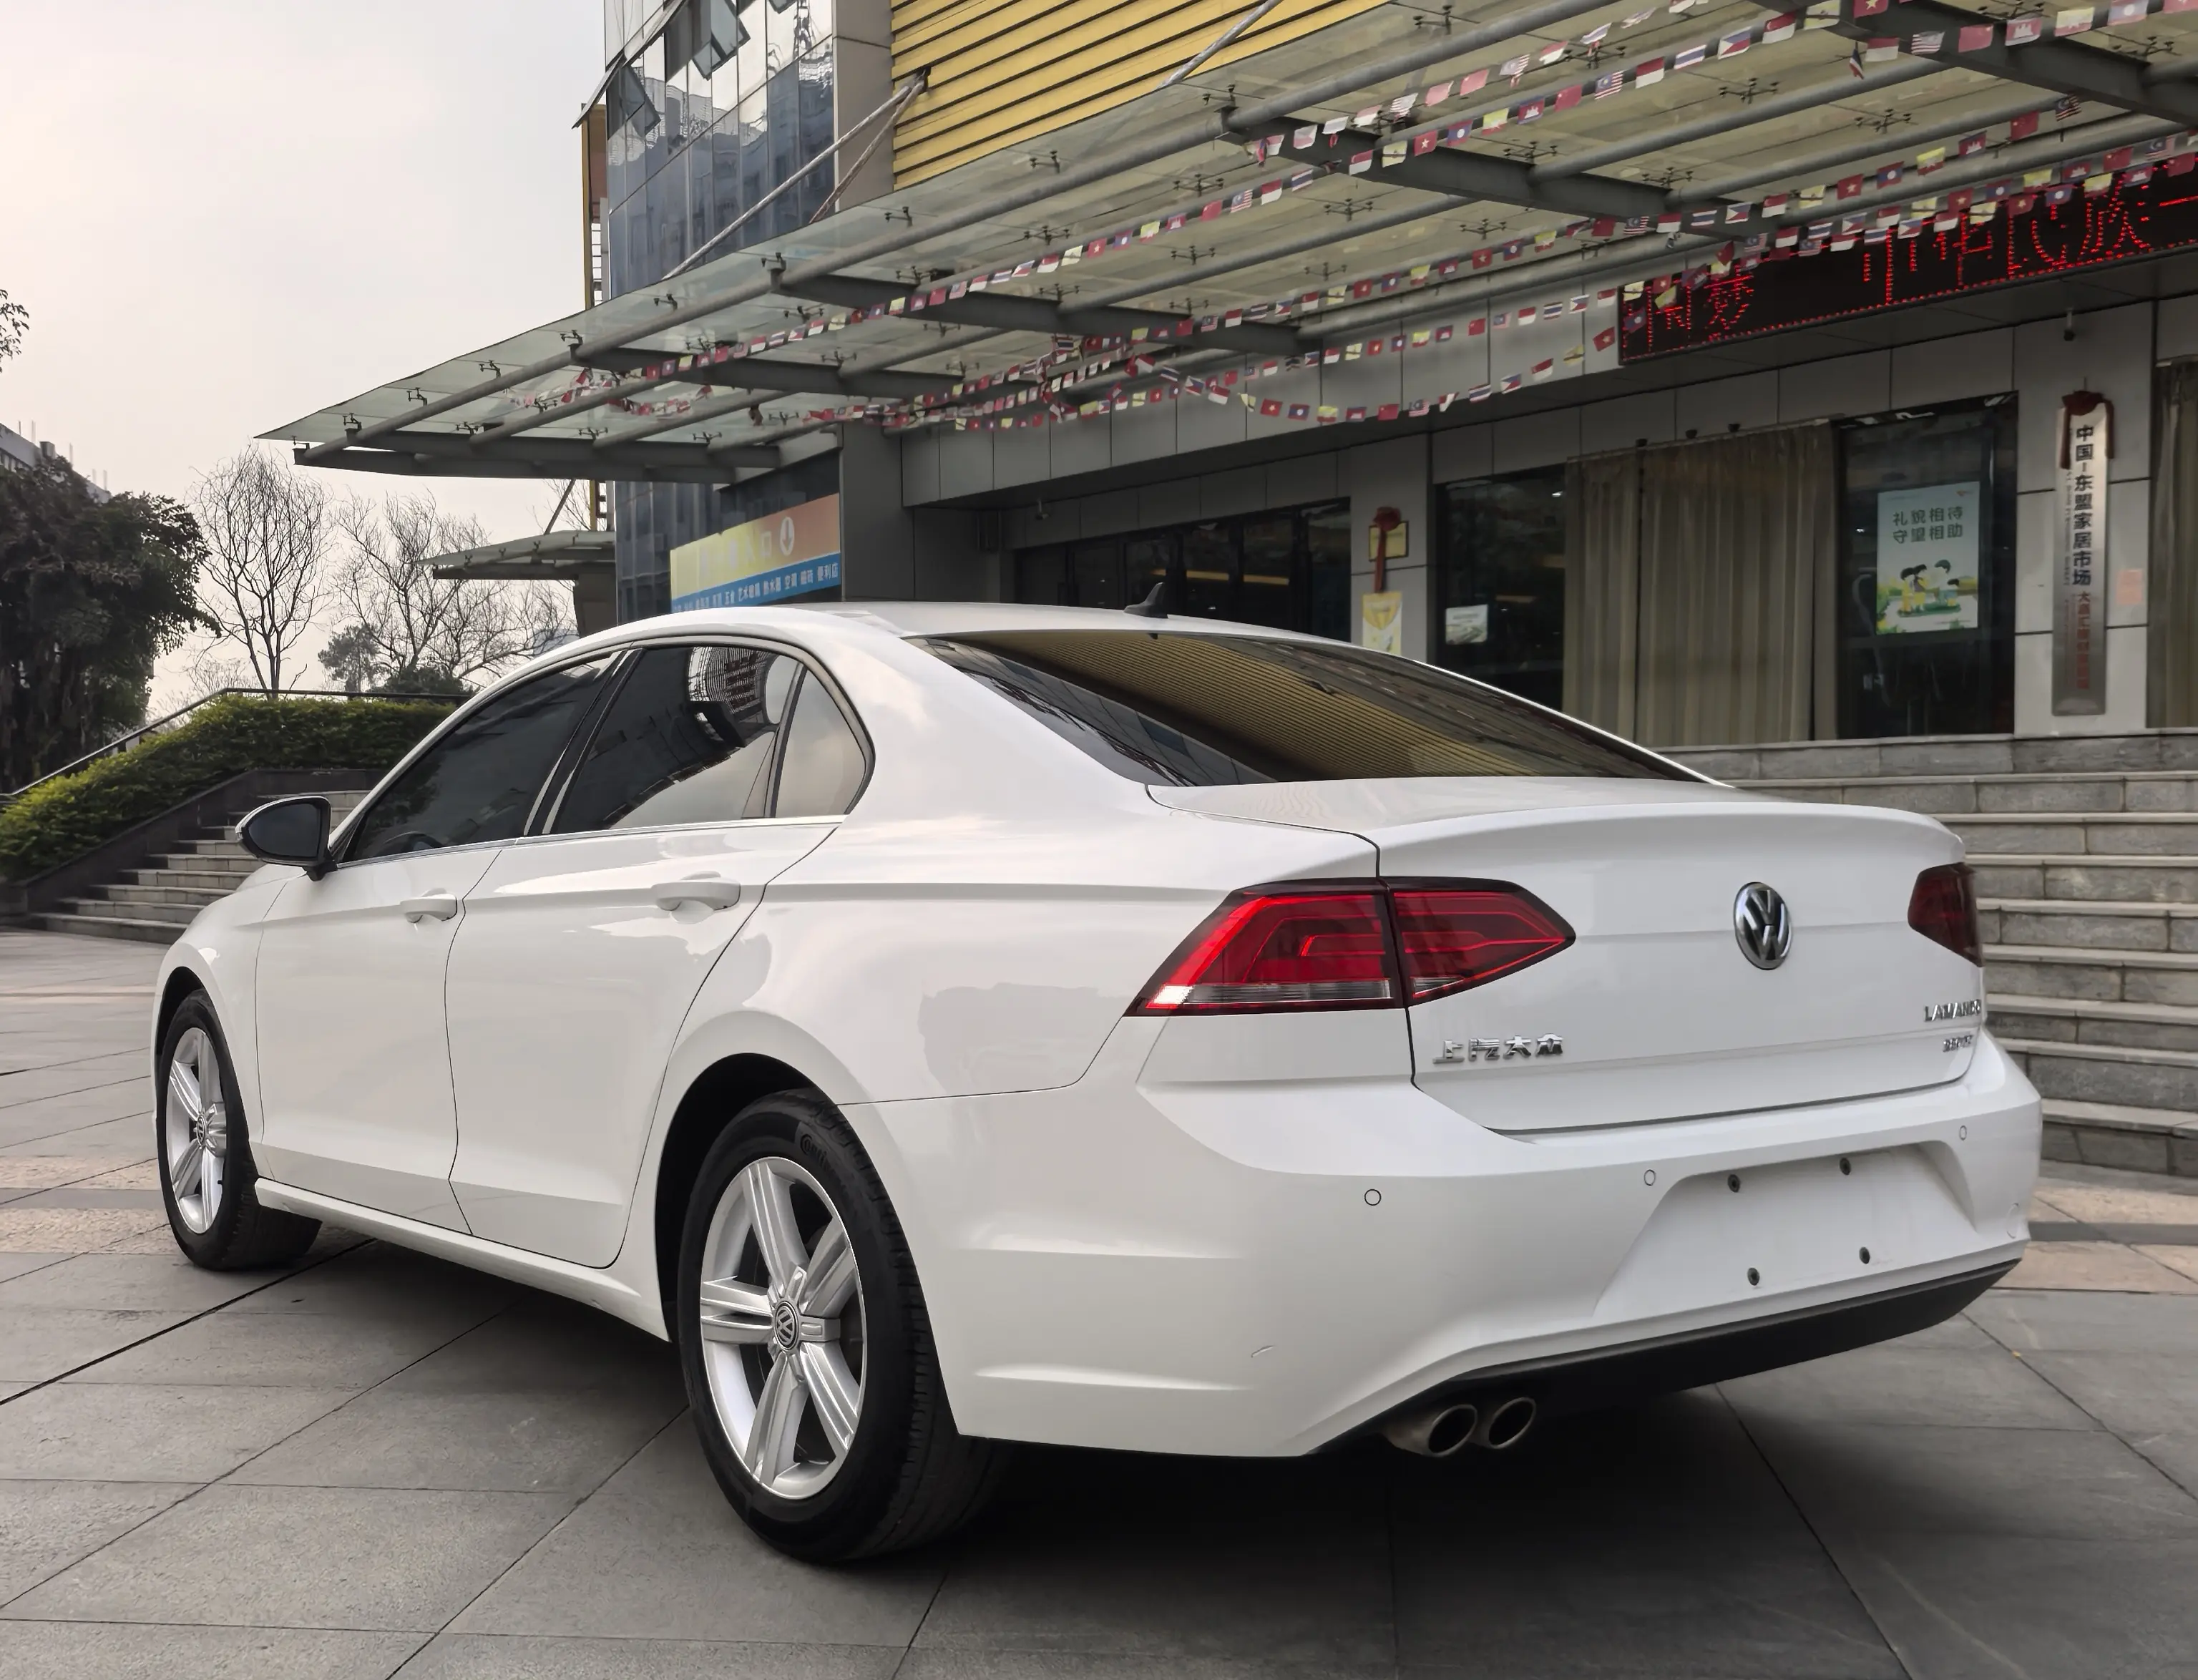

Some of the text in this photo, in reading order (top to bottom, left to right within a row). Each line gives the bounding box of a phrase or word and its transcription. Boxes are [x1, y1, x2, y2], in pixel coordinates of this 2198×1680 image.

[1892, 506, 1963, 526] 礼貌相待
[1892, 523, 1963, 544] 守望相助
[1432, 1033, 1563, 1064] 上汽大众
